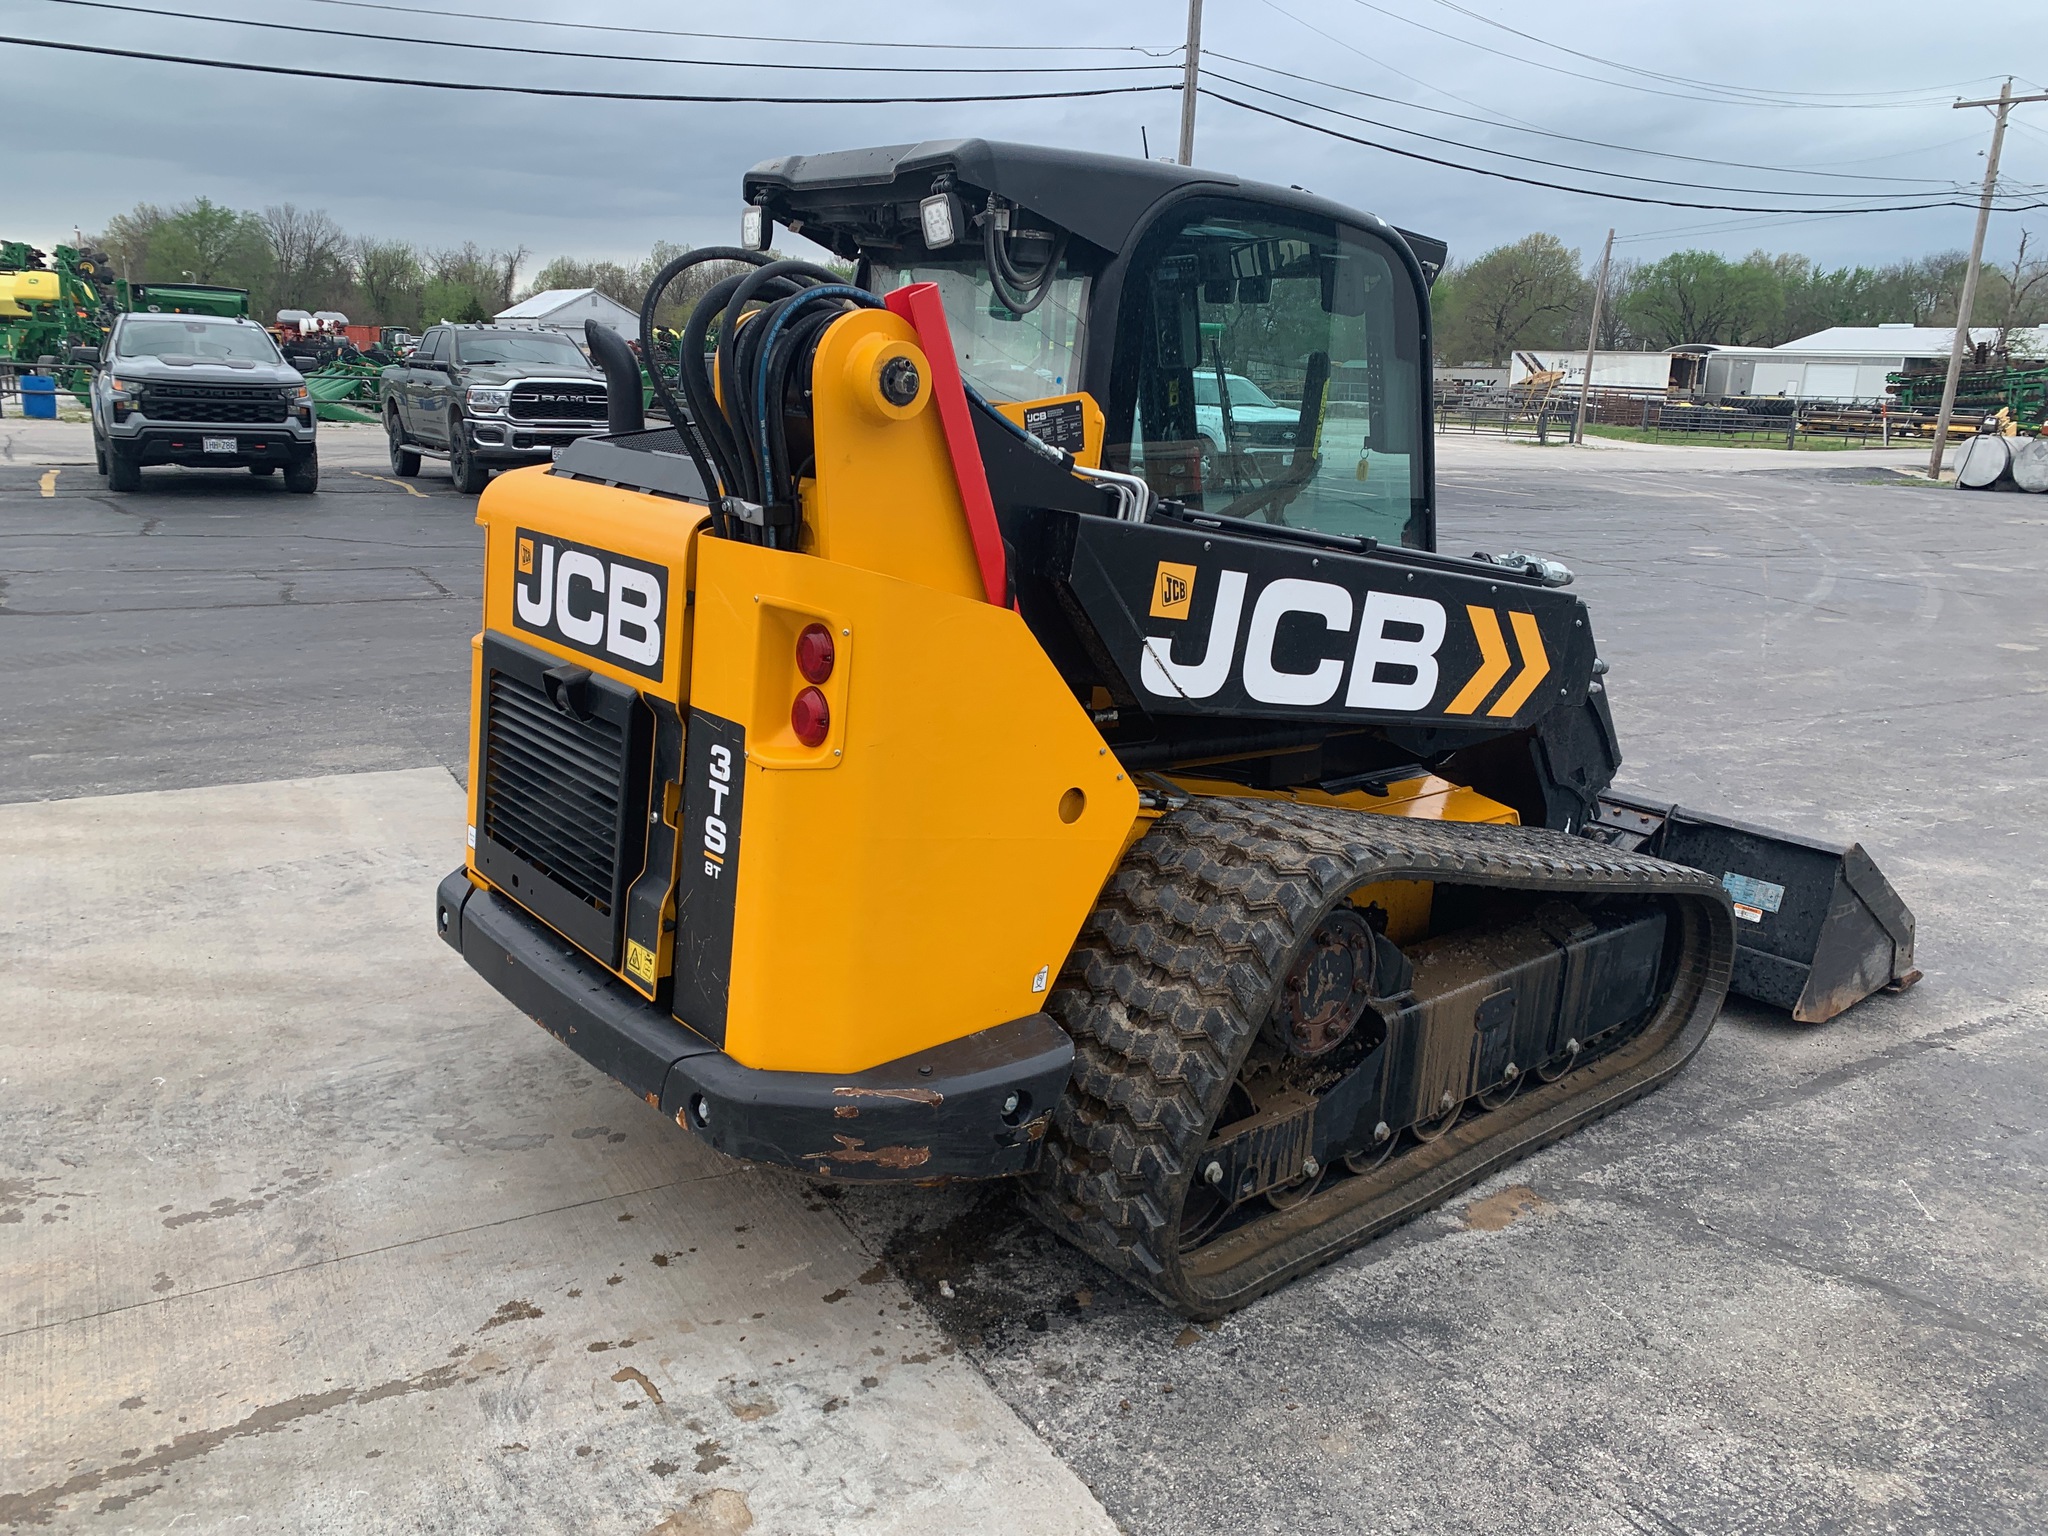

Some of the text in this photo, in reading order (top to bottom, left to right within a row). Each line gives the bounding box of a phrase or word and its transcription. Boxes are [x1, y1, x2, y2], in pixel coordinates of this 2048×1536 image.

[153, 386, 279, 398] CHEVROLET
[1027, 411, 1047, 423] JCB
[1164, 577, 1187, 602] JCB
[517, 543, 661, 666] JCB
[1140, 569, 1447, 711] JCB
[704, 744, 731, 855] 3TS
[704, 861, 721, 879] 8T
